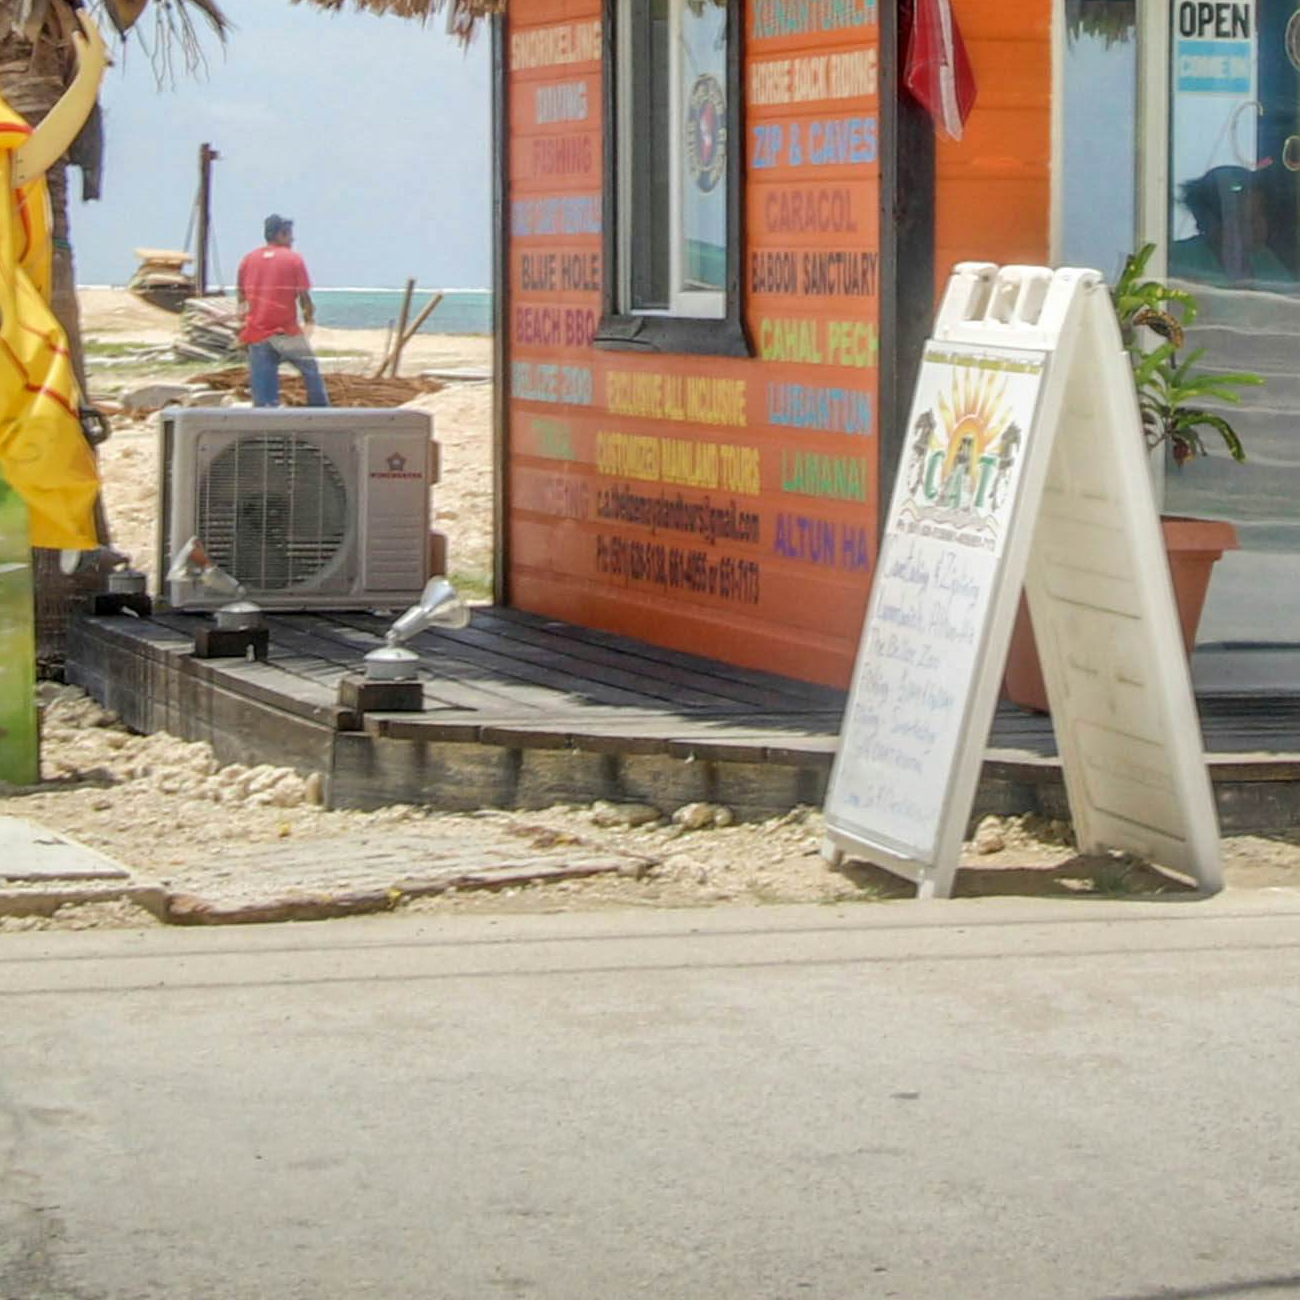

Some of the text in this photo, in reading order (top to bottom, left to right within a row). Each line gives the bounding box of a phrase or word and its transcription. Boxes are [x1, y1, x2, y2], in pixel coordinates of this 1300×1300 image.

[1180, 1, 1249, 38] OPEN
[532, 136, 592, 175] FISHING
[753, 124, 783, 168] ZIP
[810, 117, 877, 164] CAVES
[765, 190, 858, 233] CARACOL
[521, 253, 601, 292] BLUE HOLE
[752, 252, 878, 296] BABOON SANCTUARY
[516, 307, 560, 345] BEACH
[760, 317, 821, 364] CAHAL
[827, 322, 879, 368] PECH
[782, 448, 867, 502] LAMANAI
[774, 513, 836, 568] ALTUN
[842, 525, 870, 572] HA
